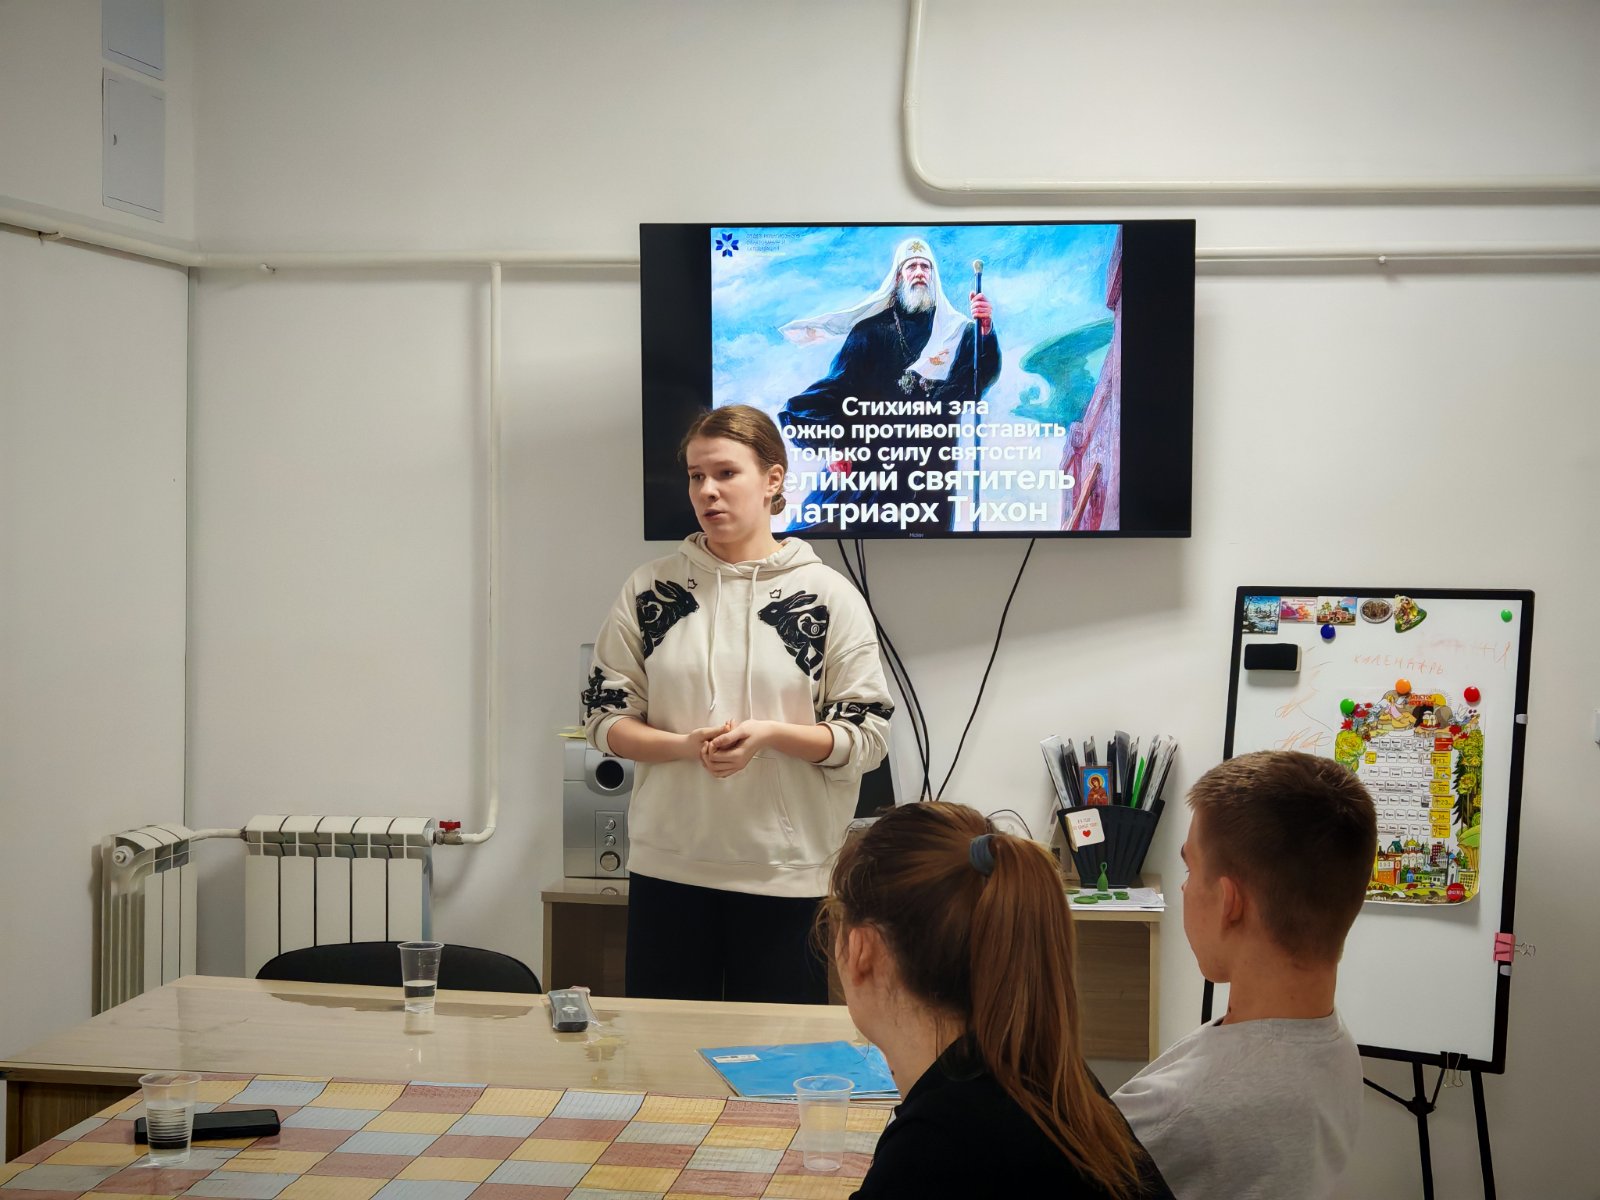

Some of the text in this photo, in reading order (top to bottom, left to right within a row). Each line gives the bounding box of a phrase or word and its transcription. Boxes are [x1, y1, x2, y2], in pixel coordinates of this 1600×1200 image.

[842, 396, 989, 416] Стихиям зла
[783, 423, 1066, 444] ожно противопоставить
[790, 446, 1041, 466] только силу святости
[784, 463, 1076, 491] еликий святитель
[947, 495, 1047, 522] Тихон
